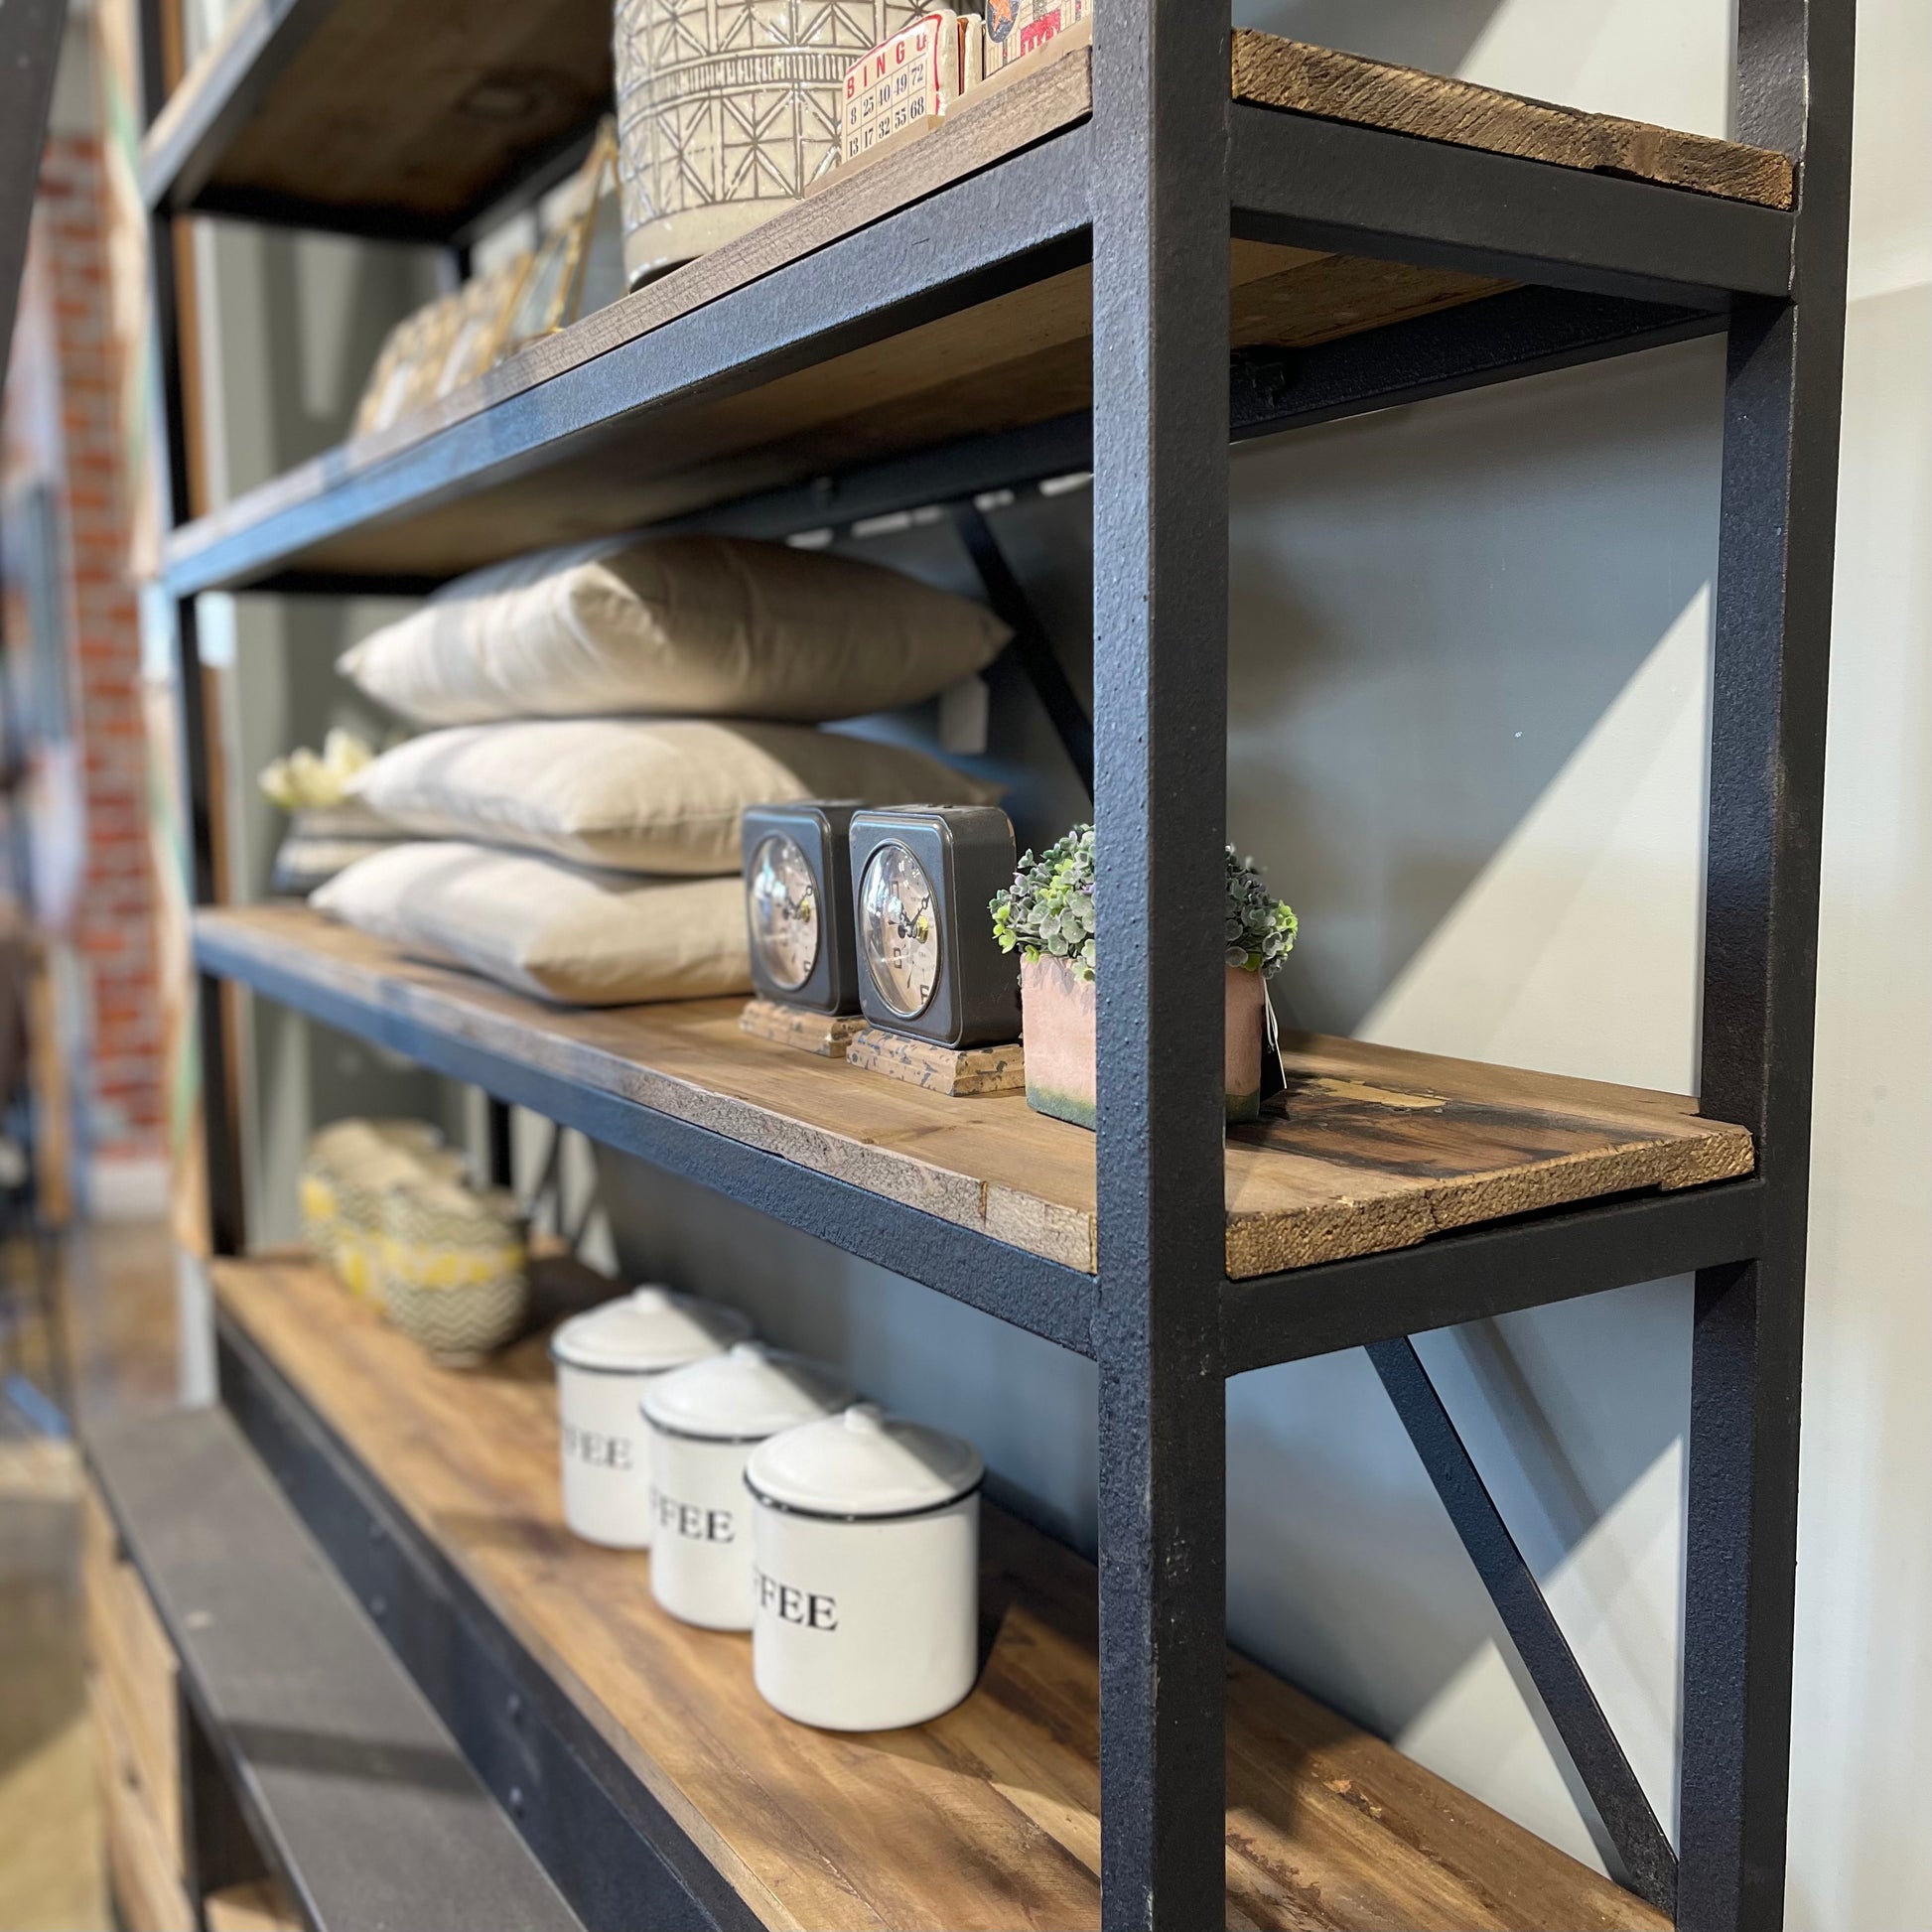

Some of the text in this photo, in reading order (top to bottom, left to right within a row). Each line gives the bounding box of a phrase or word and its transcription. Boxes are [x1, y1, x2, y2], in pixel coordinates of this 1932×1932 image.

[847, 33, 927, 99] BINGO
[850, 63, 924, 126] 8 25 40 49 72
[849, 96, 924, 158] 13 17 32 55 68
[652, 1489, 735, 1544] FEE
[755, 1569, 839, 1632] FEE
